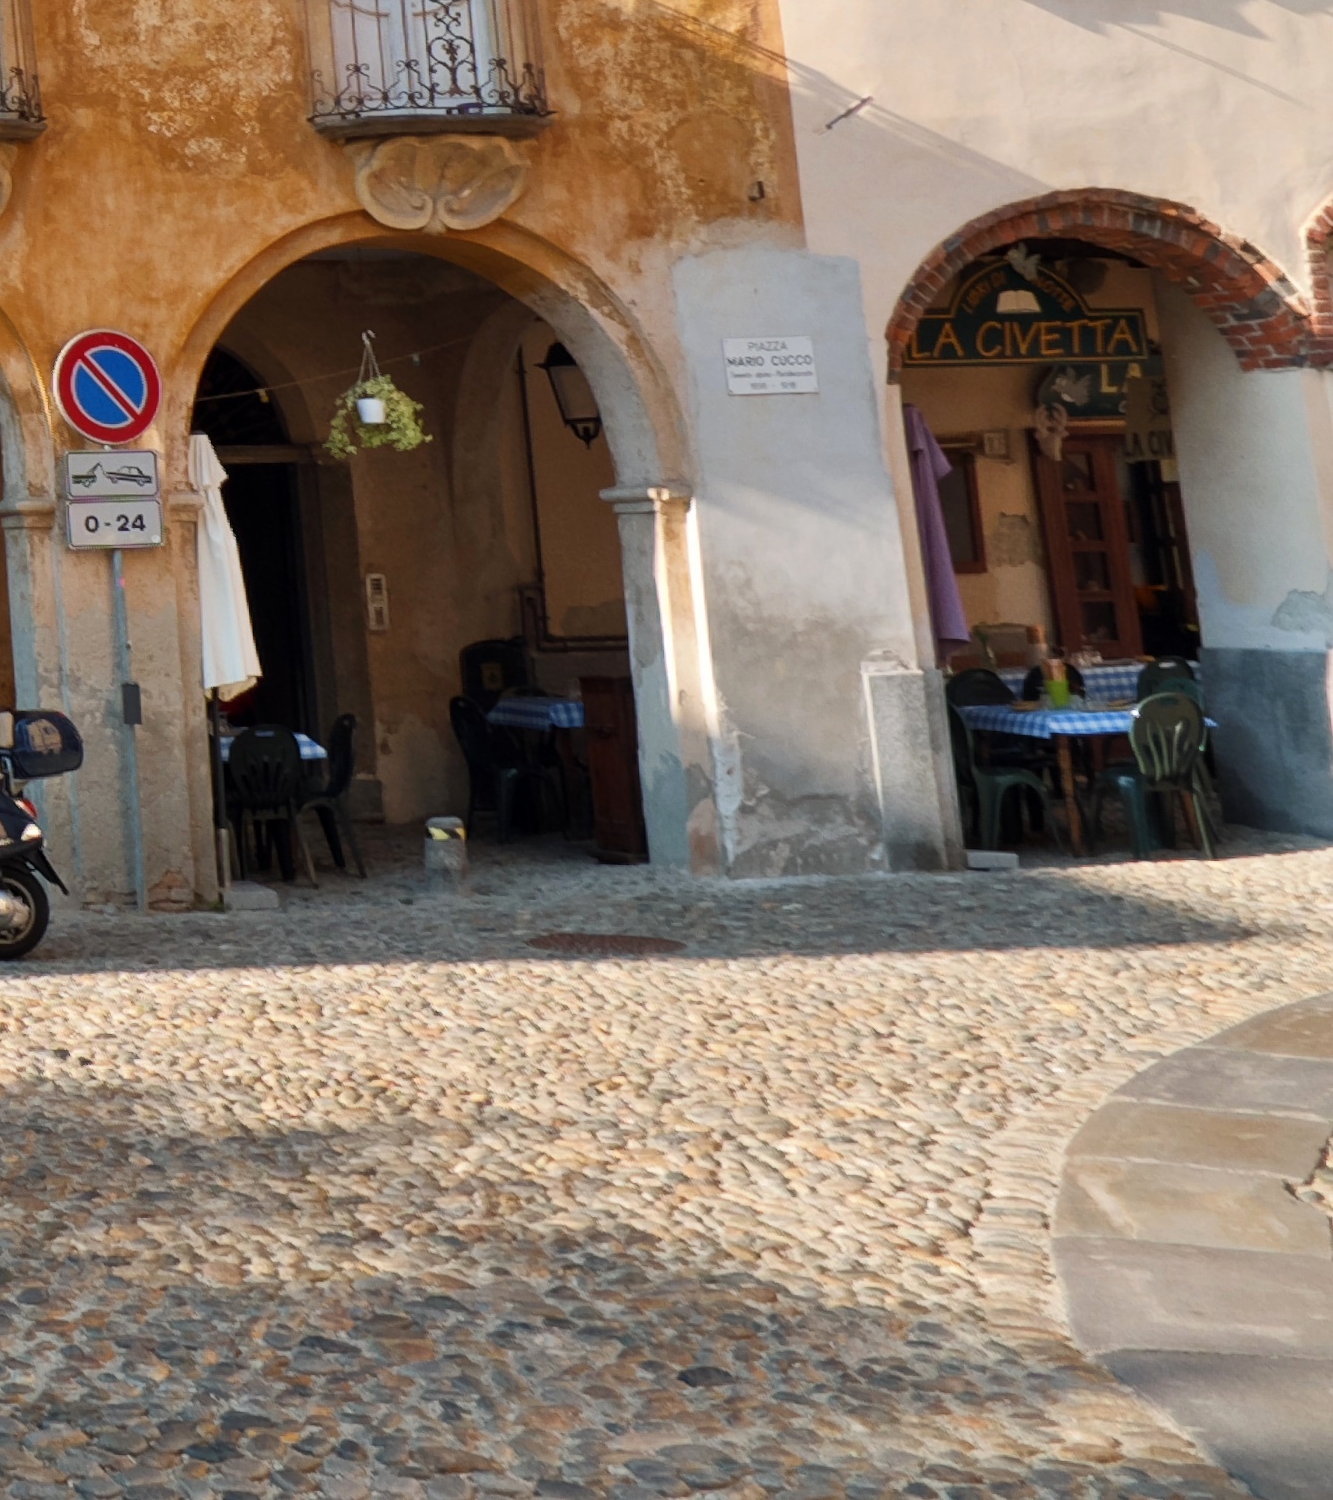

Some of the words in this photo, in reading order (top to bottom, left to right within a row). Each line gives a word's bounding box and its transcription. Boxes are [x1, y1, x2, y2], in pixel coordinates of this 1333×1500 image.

[911, 321, 965, 359] LA
[975, 317, 1139, 357] CIVETTA
[747, 340, 789, 352] PIAZZA
[726, 355, 765, 368] MARIO
